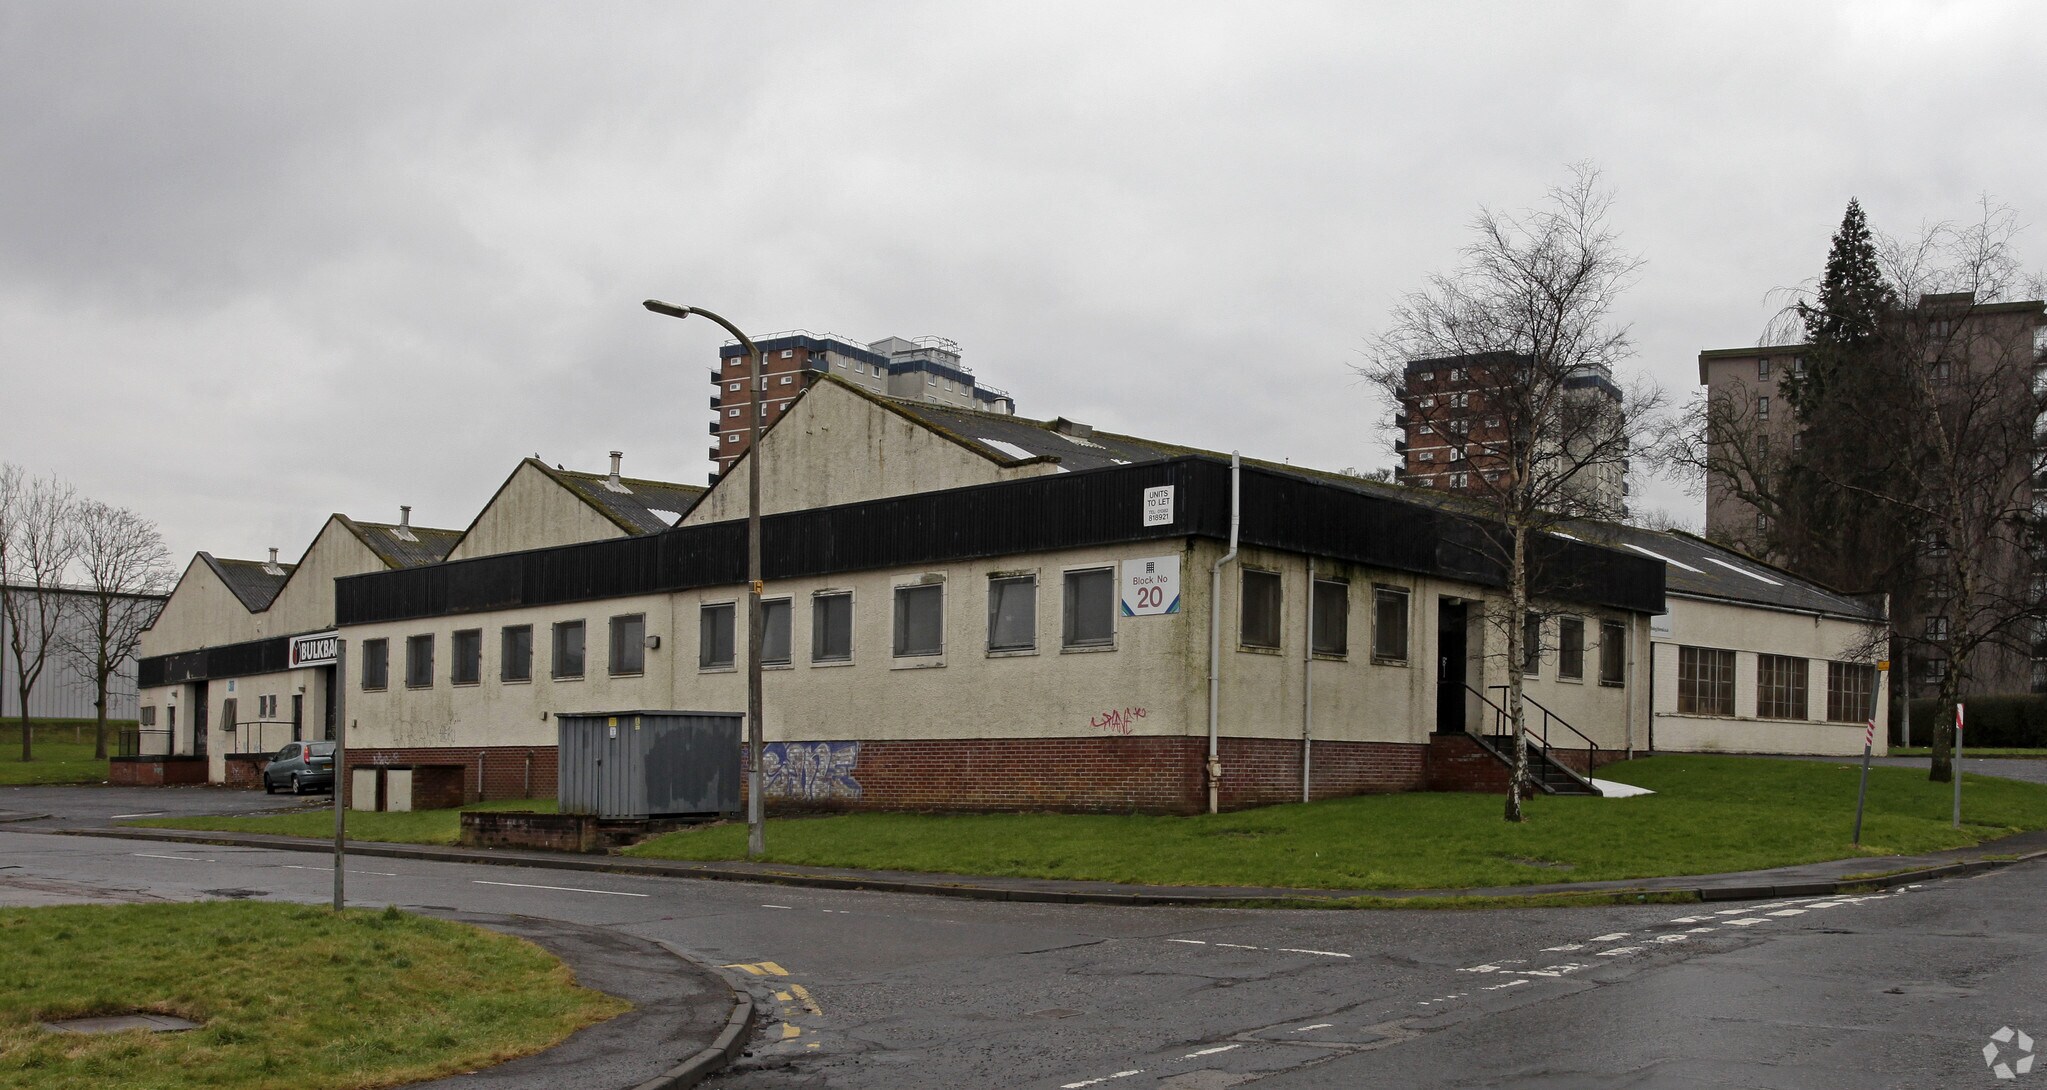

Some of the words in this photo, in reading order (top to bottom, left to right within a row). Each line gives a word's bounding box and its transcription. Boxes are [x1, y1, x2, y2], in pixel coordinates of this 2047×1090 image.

[1149, 490, 1169, 499] UNITS
[1147, 499, 1157, 507] TO
[1158, 497, 1171, 506] LET
[1148, 513, 1169, 522] 818921
[1132, 576, 1154, 586] Block
[1157, 575, 1168, 584] No
[1137, 586, 1163, 609] 20
